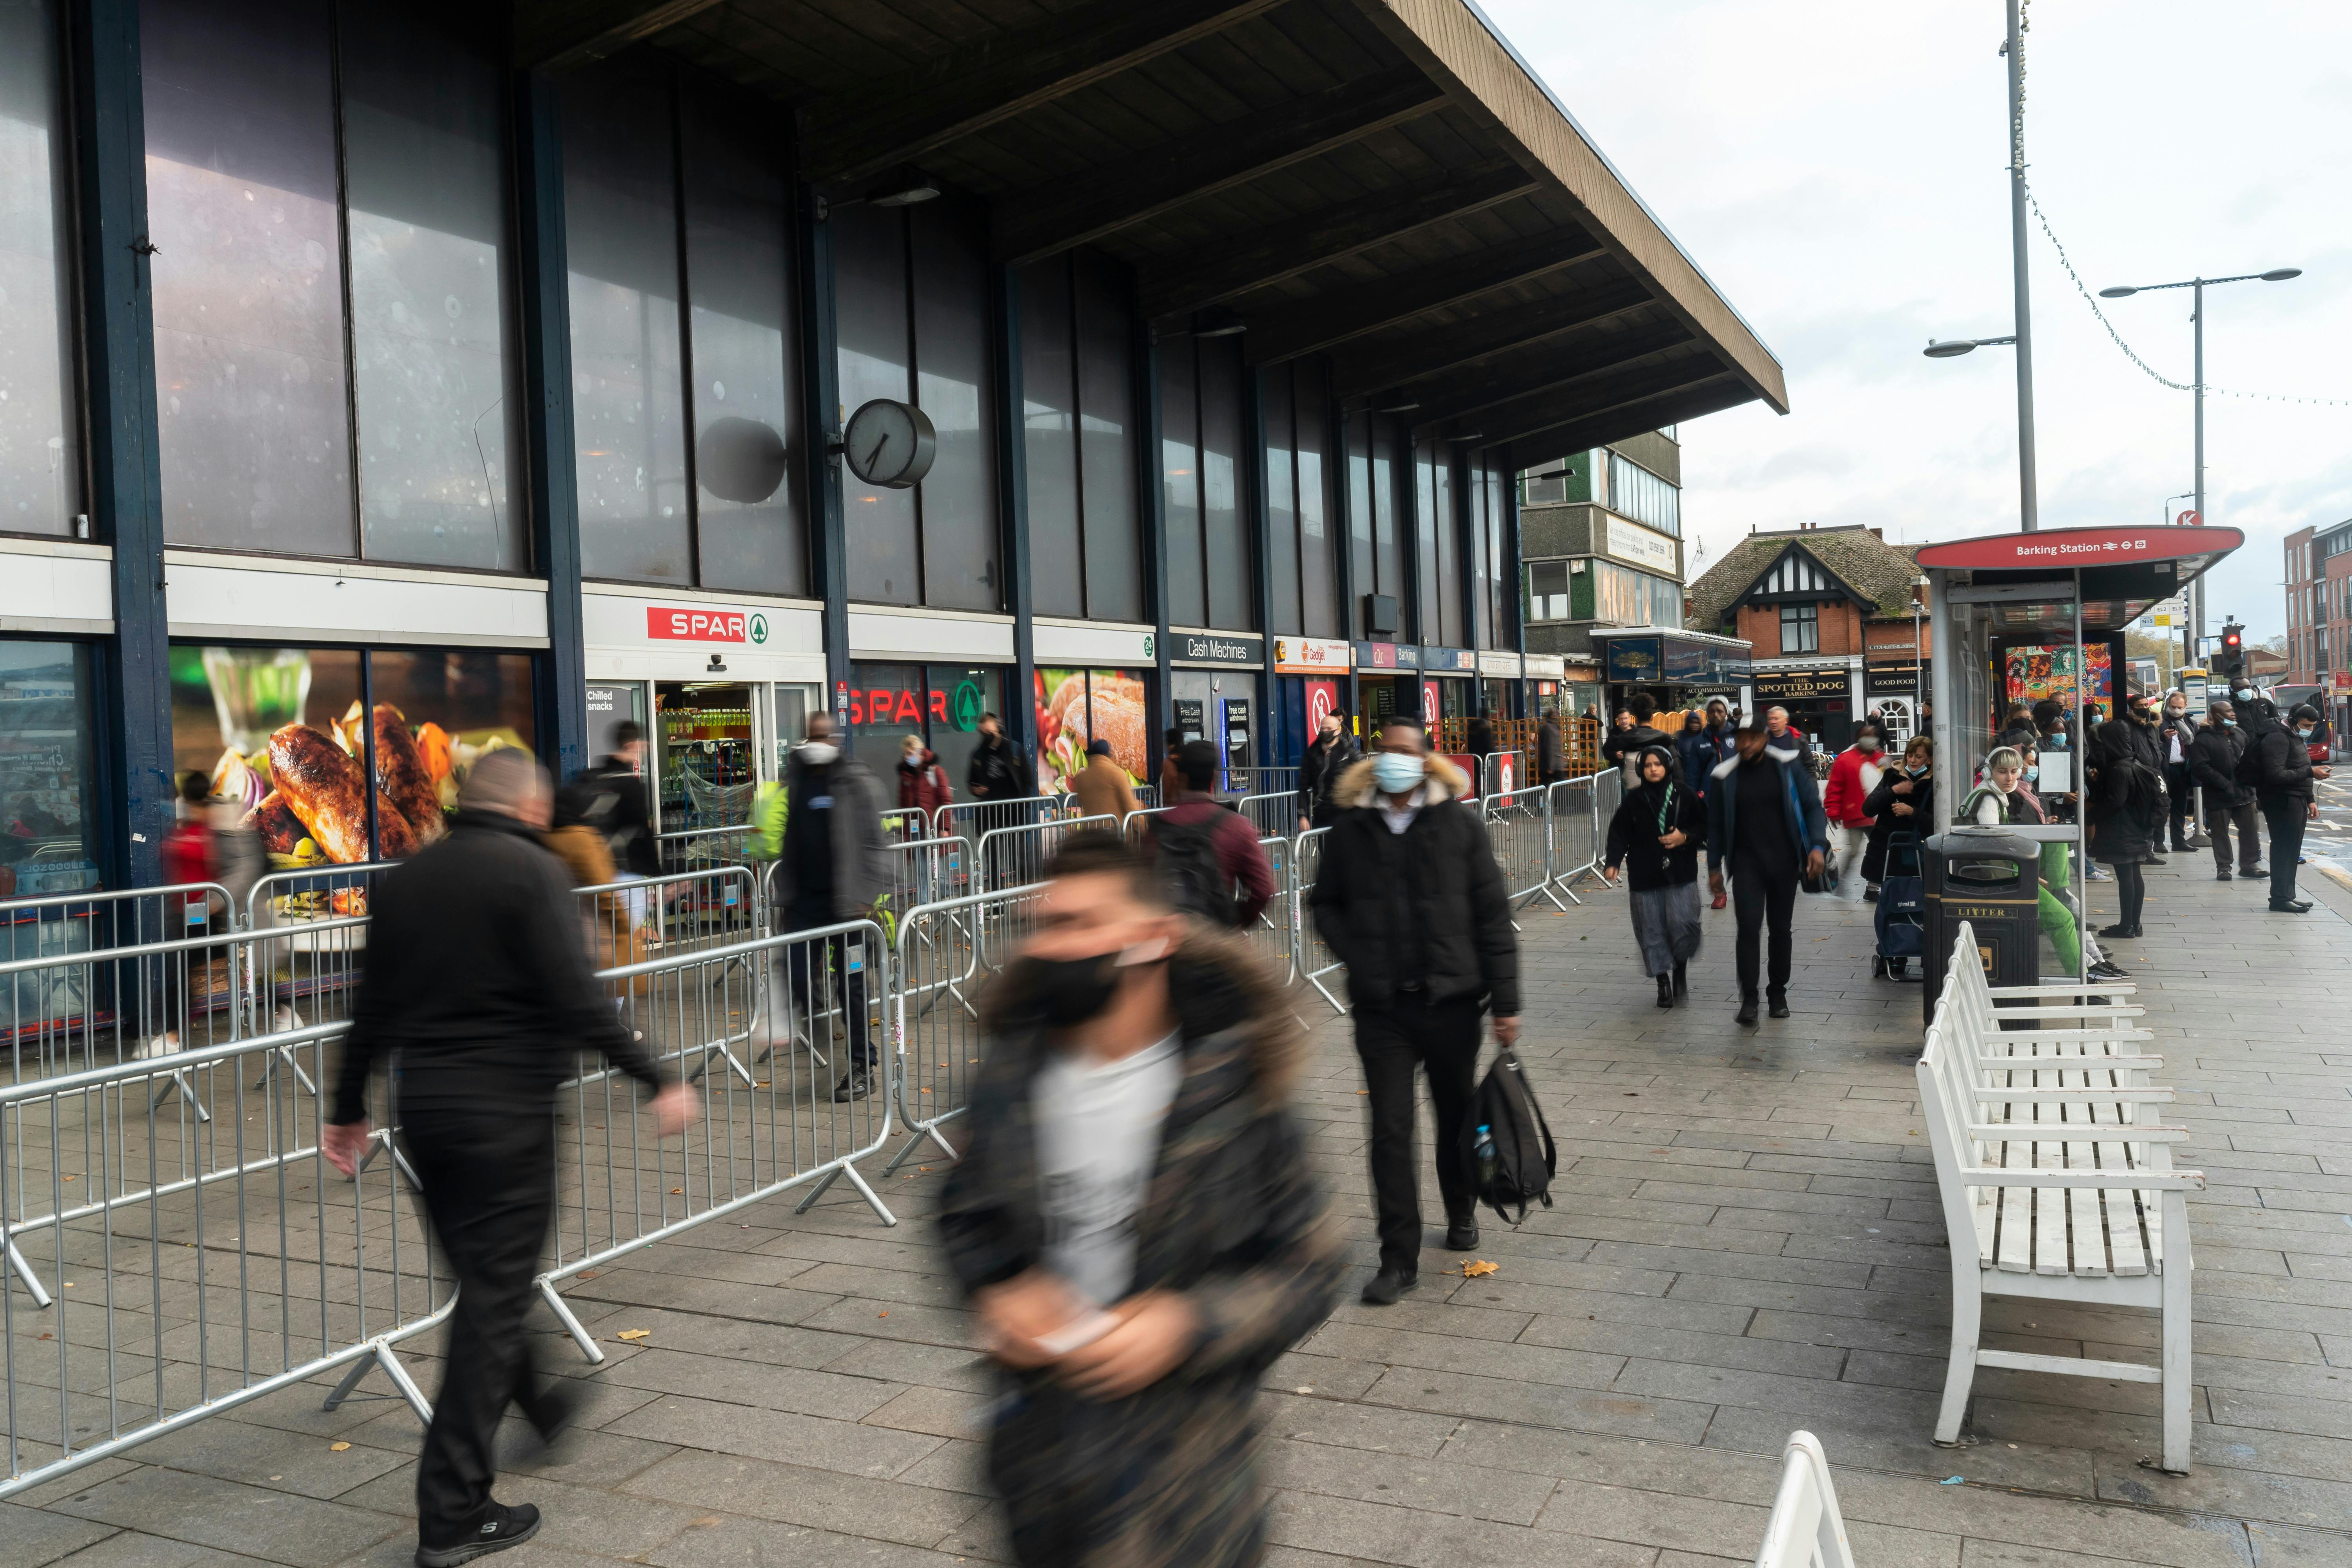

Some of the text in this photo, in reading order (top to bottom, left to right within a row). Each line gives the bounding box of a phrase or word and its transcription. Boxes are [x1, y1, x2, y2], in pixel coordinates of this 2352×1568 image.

[2182, 513, 2196, 525] K
[2017, 543, 2100, 555] Barking Station
[671, 613, 744, 637] SPAR
[1145, 640, 1152, 649] 24
[1188, 638, 1246, 659] Cash Machines
[1309, 648, 1325, 663] Gadget
[1374, 648, 1384, 664] c2c
[1398, 648, 1416, 664] Barking
[1758, 681, 1845, 693] SPOTTED DOG
[587, 690, 612, 700] Chilled
[588, 701, 613, 710] snacks
[851, 690, 947, 724] SPAR
[1180, 707, 1200, 716] Free Cash
[1229, 705, 1246, 714] free cash
